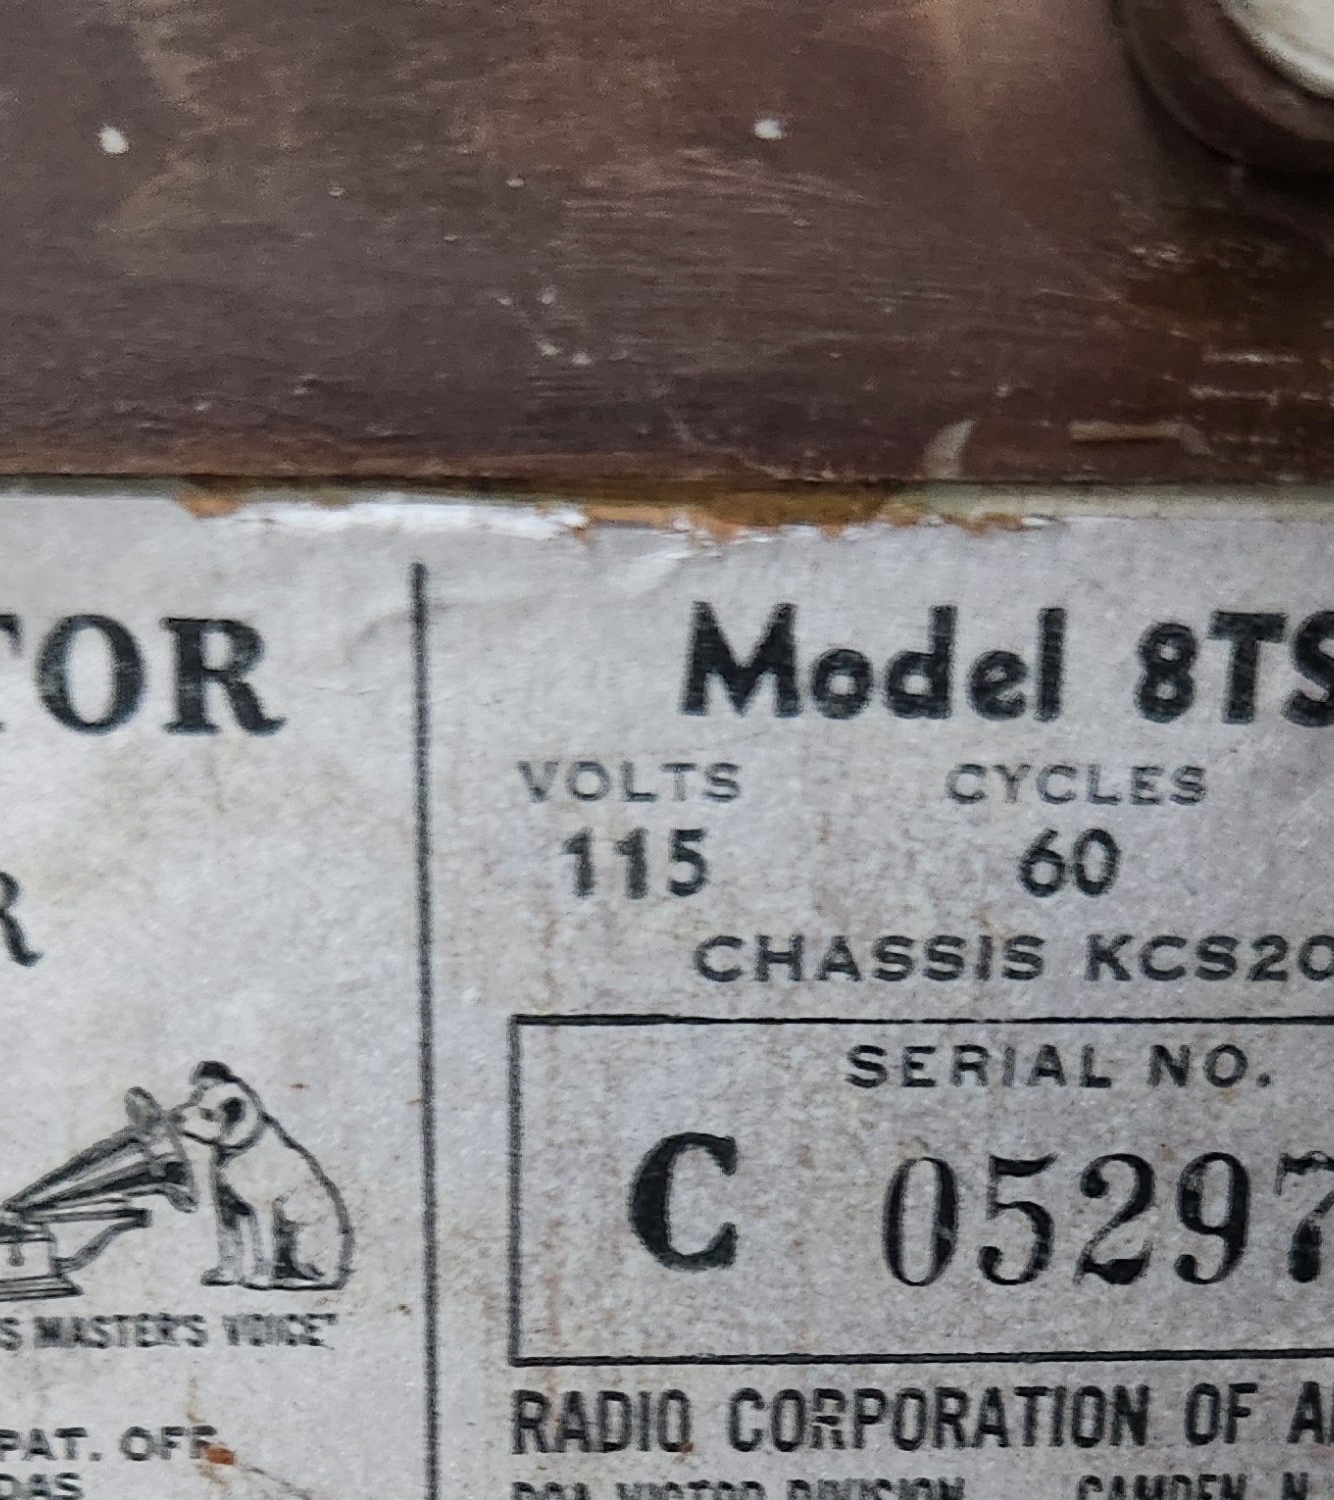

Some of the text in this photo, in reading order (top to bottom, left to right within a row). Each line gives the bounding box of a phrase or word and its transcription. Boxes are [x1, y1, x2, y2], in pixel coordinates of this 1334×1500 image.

[678, 601, 1066, 722] Model
[518, 760, 742, 803] VOLTS
[945, 763, 1207, 806] CYCLES
[562, 828, 711, 899] 115
[1017, 828, 1121, 898] 60
[693, 934, 1046, 983] CHASSIS
[847, 1044, 1271, 1089] SERIAL NO.
[629, 1131, 738, 1273] C
[511, 1388, 692, 1455] RADIO
[728, 1383, 1150, 1453] CORPORATION
[1184, 1382, 1258, 1448] OF
